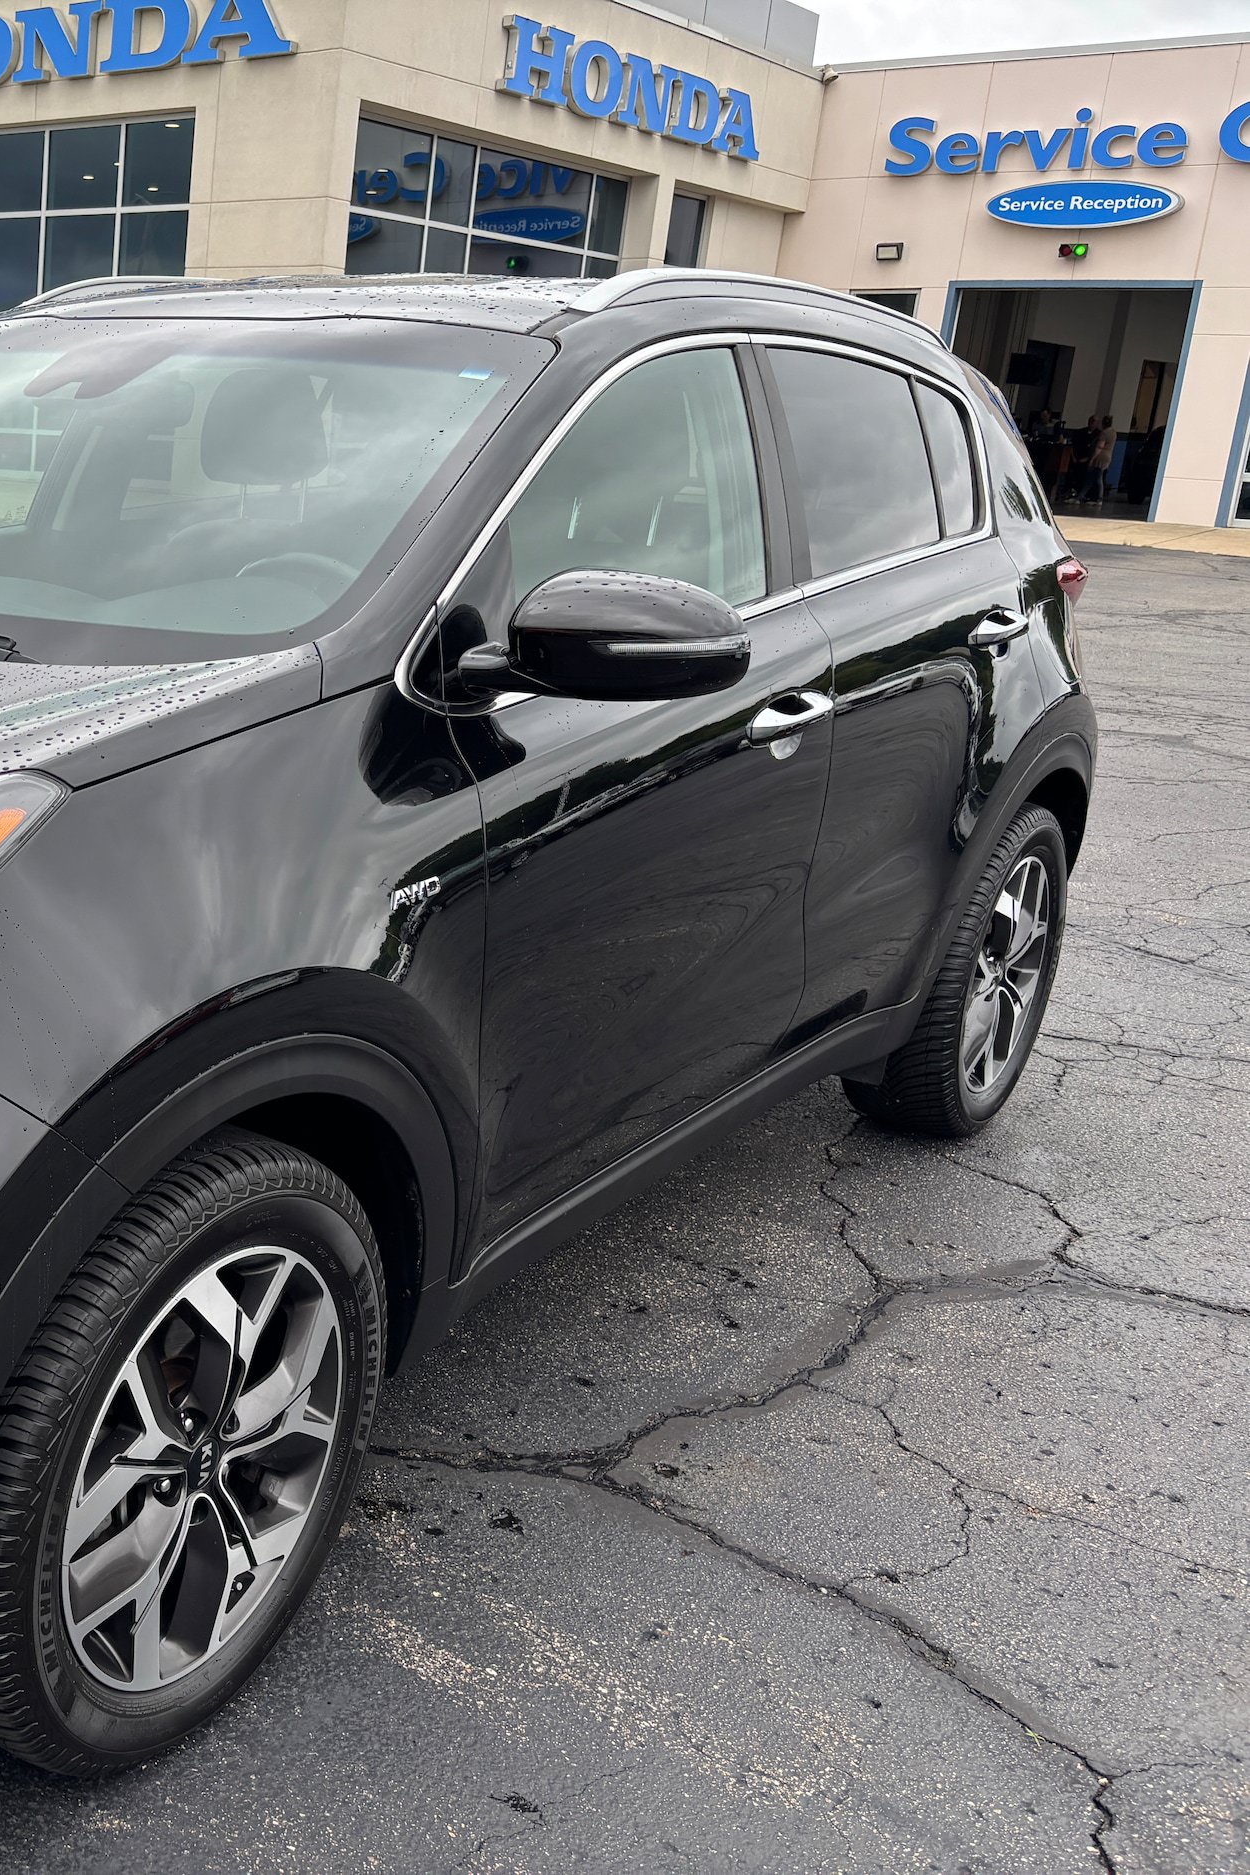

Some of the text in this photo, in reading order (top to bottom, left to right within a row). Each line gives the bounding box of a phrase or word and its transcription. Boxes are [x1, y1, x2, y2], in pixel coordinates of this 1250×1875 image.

[500, 14, 760, 161] HONDA
[884, 107, 1189, 177] Service
[999, 194, 1163, 214] Service Reception
[391, 876, 441, 911] AWD
[358, 1305, 377, 1441] MICHELIN
[197, 1442, 213, 1486] KIA
[40, 1513, 60, 1673] MICHELIN
